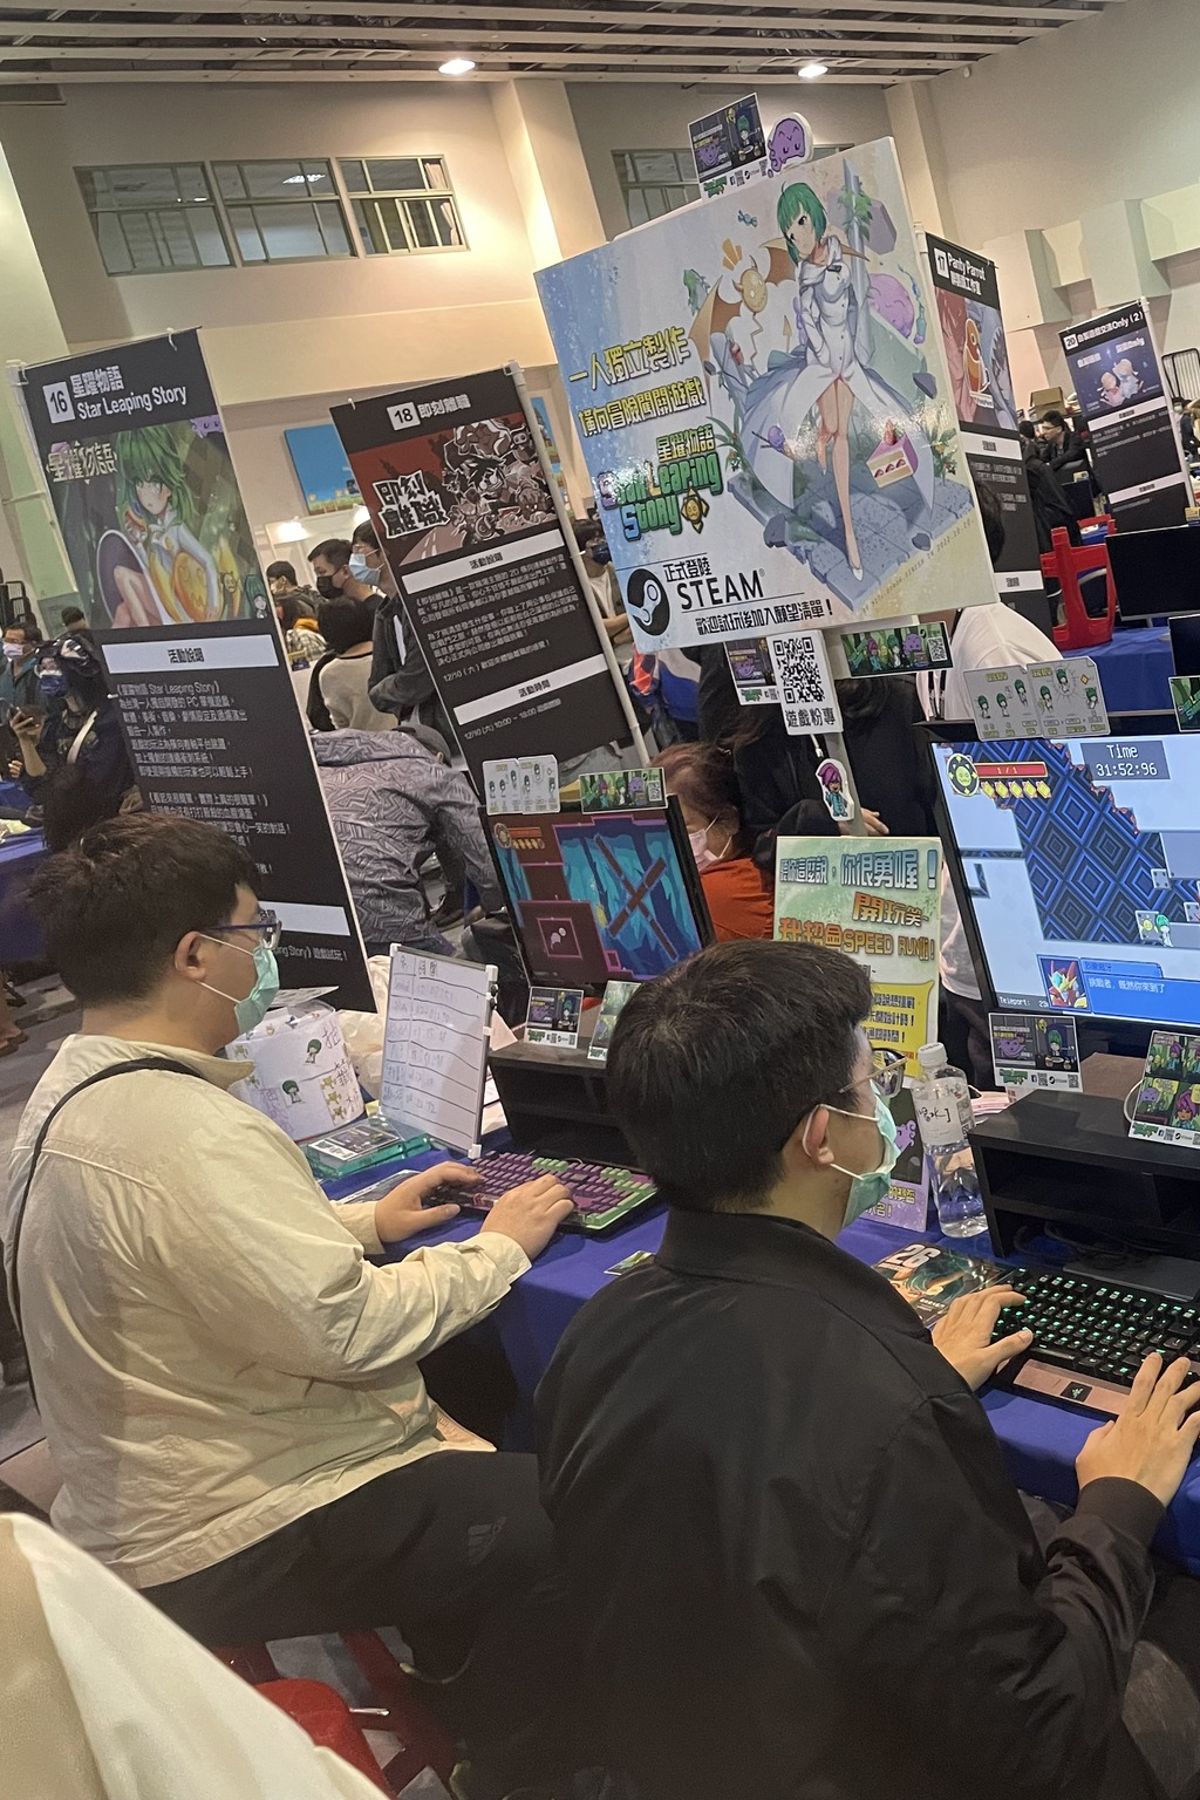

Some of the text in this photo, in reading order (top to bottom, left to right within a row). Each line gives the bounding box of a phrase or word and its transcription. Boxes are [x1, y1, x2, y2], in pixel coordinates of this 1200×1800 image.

[569, 326, 691, 390] 一人獨立製作
[70, 366, 124, 398] 星躍物語
[50, 390, 68, 414] 16
[77, 386, 187, 420] Star Leaping Story
[394, 408, 413, 424] 18
[578, 376, 706, 437] 橫向冒險闖關遊戲
[663, 557, 712, 583] 正式登陸
[677, 570, 764, 610] STEAM
[696, 599, 833, 635] 歡迎試玩後加入願望清單！
[785, 707, 836, 728] 遊戲粉專
[1106, 745, 1139, 758] Time
[1095, 763, 1158, 776] 31:52:96
